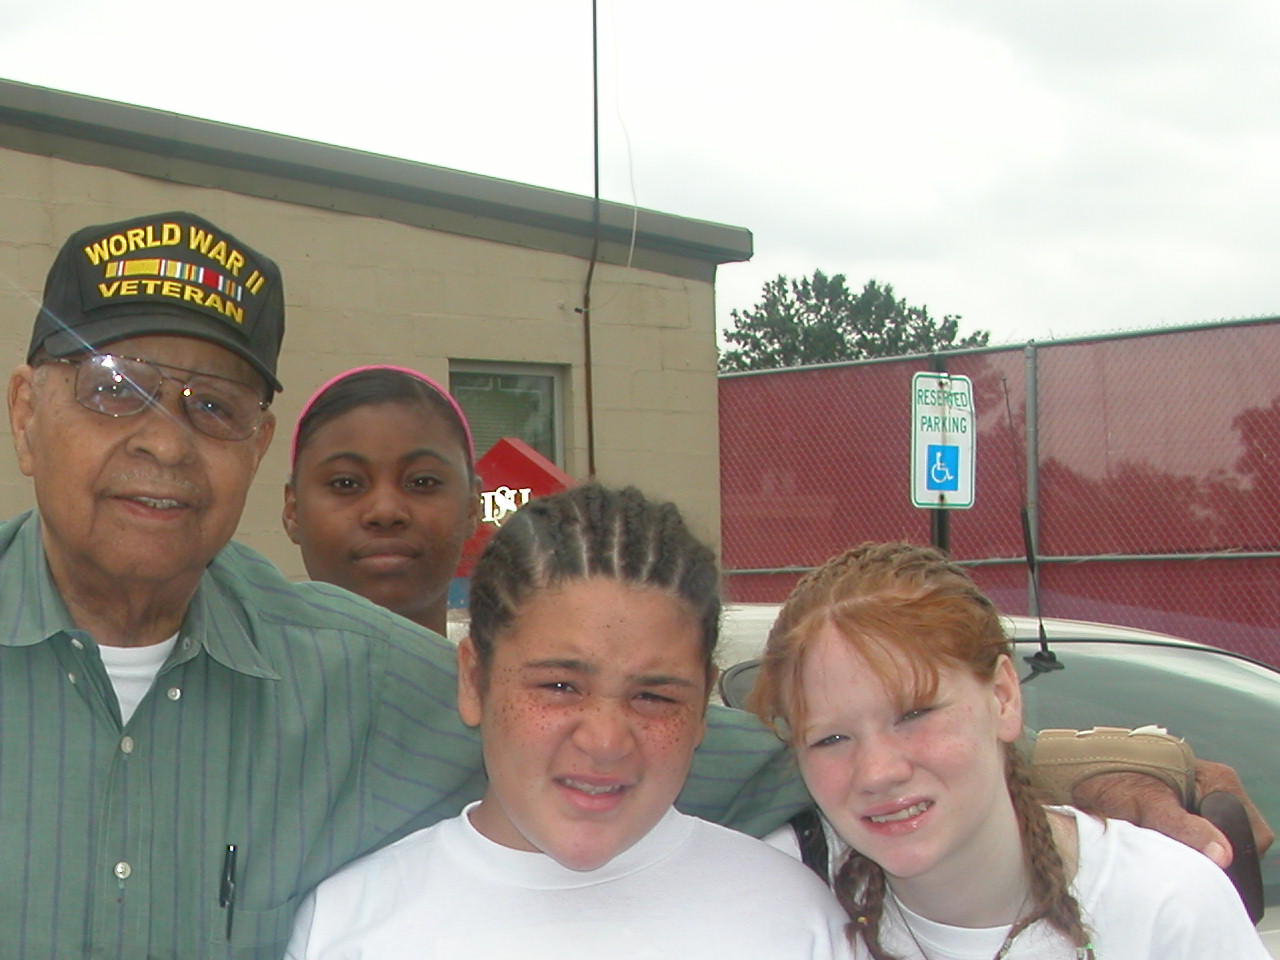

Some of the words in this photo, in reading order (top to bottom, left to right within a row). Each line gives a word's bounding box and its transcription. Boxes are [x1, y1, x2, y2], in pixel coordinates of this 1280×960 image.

[84, 222, 182, 266] WORLD
[189, 225, 245, 277] WAR
[245, 269, 265, 295] II
[98, 279, 245, 324] VETERAN
[917, 389, 968, 407] RESERVED
[921, 416, 967, 433] PARKING
